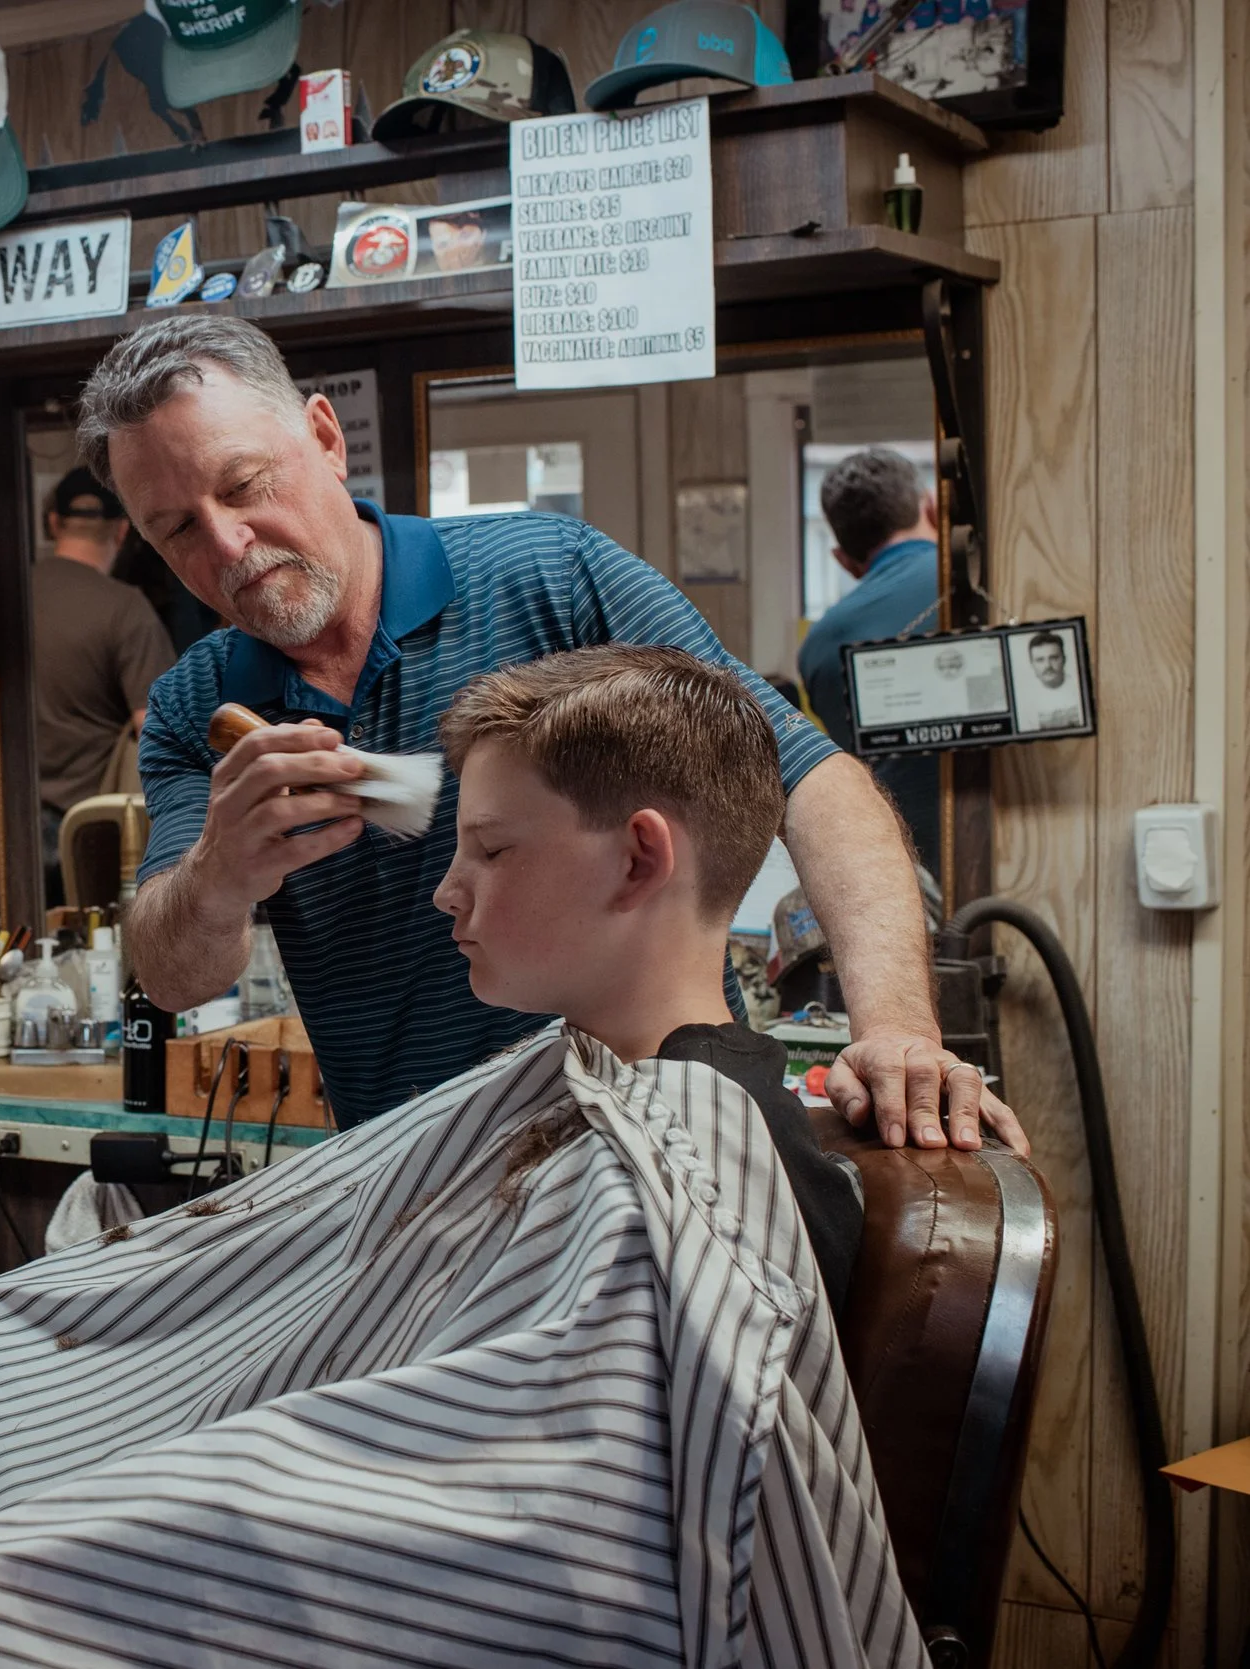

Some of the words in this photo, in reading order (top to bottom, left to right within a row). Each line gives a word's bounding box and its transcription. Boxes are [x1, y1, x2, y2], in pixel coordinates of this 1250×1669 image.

[178, 5, 246, 36] SHERIFF
[192, 4, 218, 19] FOR
[697, 31, 735, 56] bbq
[522, 121, 589, 161] BIDEN
[594, 115, 655, 153] PRICE
[658, 103, 702, 144] LIST
[517, 168, 597, 198] MEN/BOYS
[599, 159, 663, 191] HAIRCUT:
[664, 154, 693, 182] $20
[518, 198, 587, 226] SENIORS:
[590, 193, 622, 220] $15
[518, 224, 599, 253] VETERANS:
[601, 221, 623, 247] $2
[625, 212, 693, 244] DISCOUNT
[520, 255, 572, 281] FAMILY
[574, 251, 617, 278] RATE:
[520, 284, 563, 309] BUZZ:
[565, 280, 598, 306] $10
[521, 309, 595, 336] LIBERALS:
[598, 305, 639, 332] $100
[521, 335, 616, 363] VACCINATED:
[618, 332, 683, 358] ADDITIONAL
[685, 326, 706, 352] $5
[905, 723, 964, 745] WOODY
